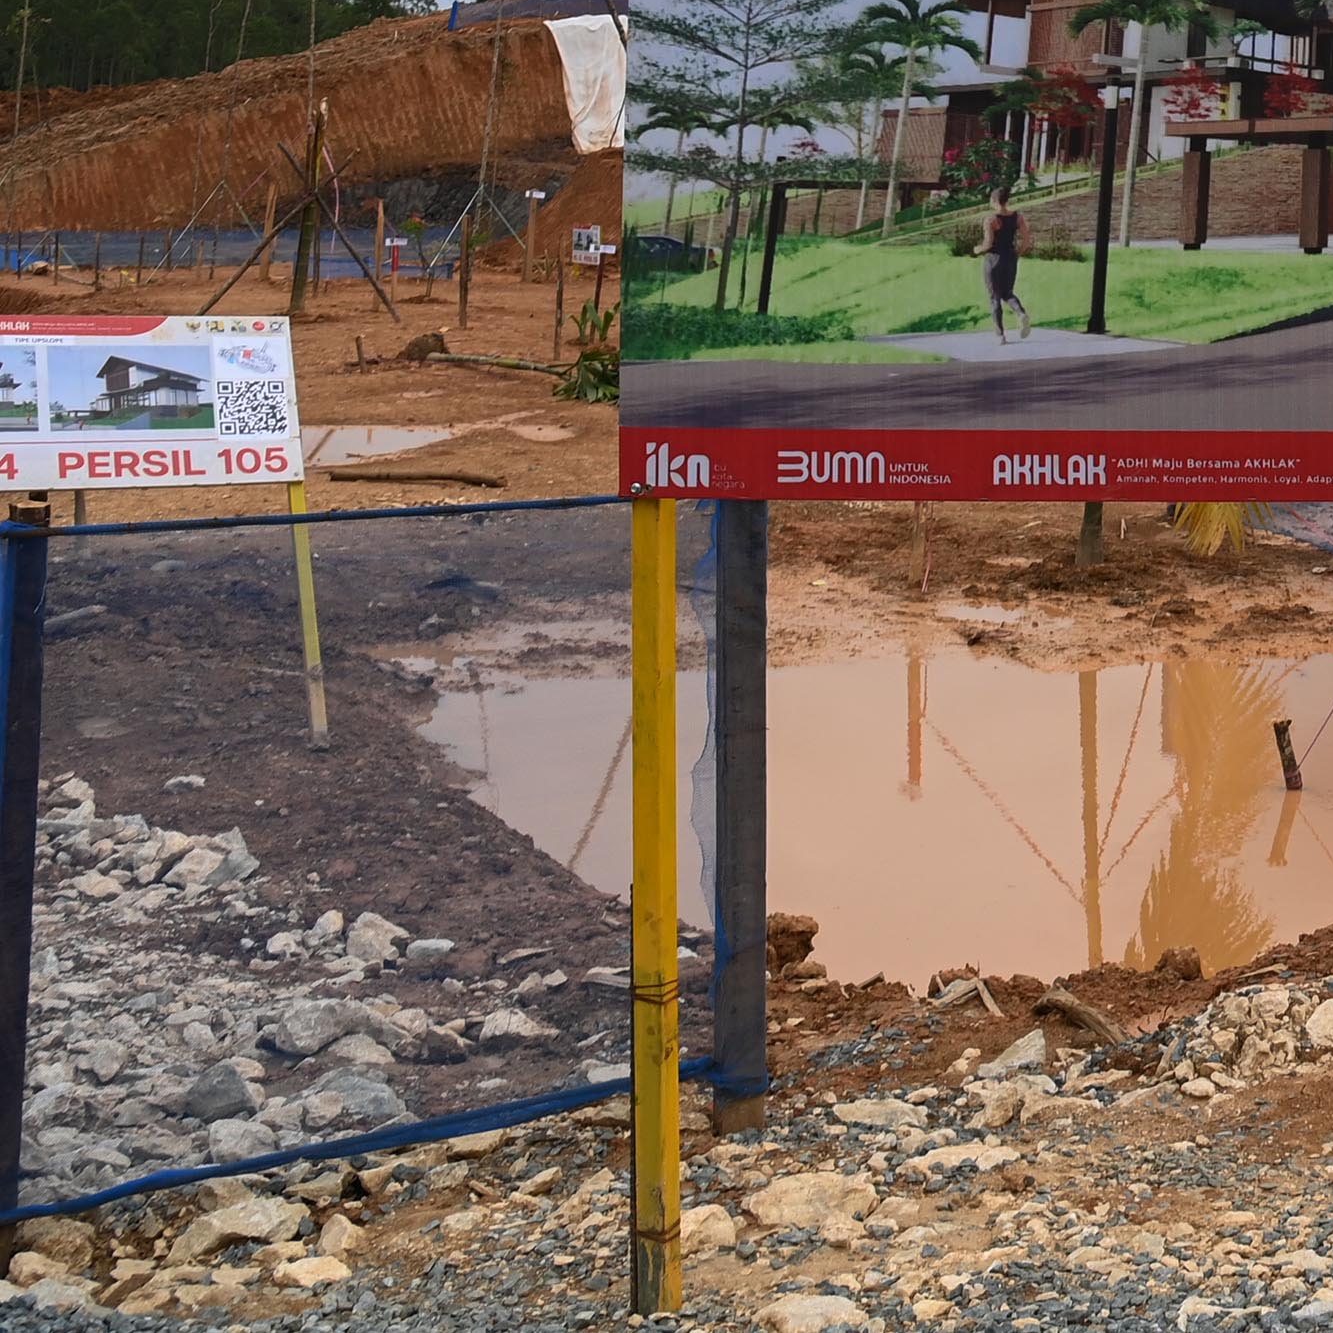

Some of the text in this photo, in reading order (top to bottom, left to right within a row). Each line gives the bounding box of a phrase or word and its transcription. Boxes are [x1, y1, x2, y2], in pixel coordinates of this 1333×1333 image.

[0, 322, 30, 331] KHLAK
[58, 449, 206, 479] PERSIL
[217, 447, 289, 475] 105
[646, 442, 710, 488] ikn
[889, 463, 929, 472] UNTUK
[1152, 458, 1182, 471] Maju
[1186, 458, 1240, 469] Bersama
[993, 454, 1106, 485] AKHLAK
[889, 474, 951, 484] INDONESIA
[1116, 474, 1160, 484] Amanah,
[1163, 474, 1217, 485] Kompeten,
